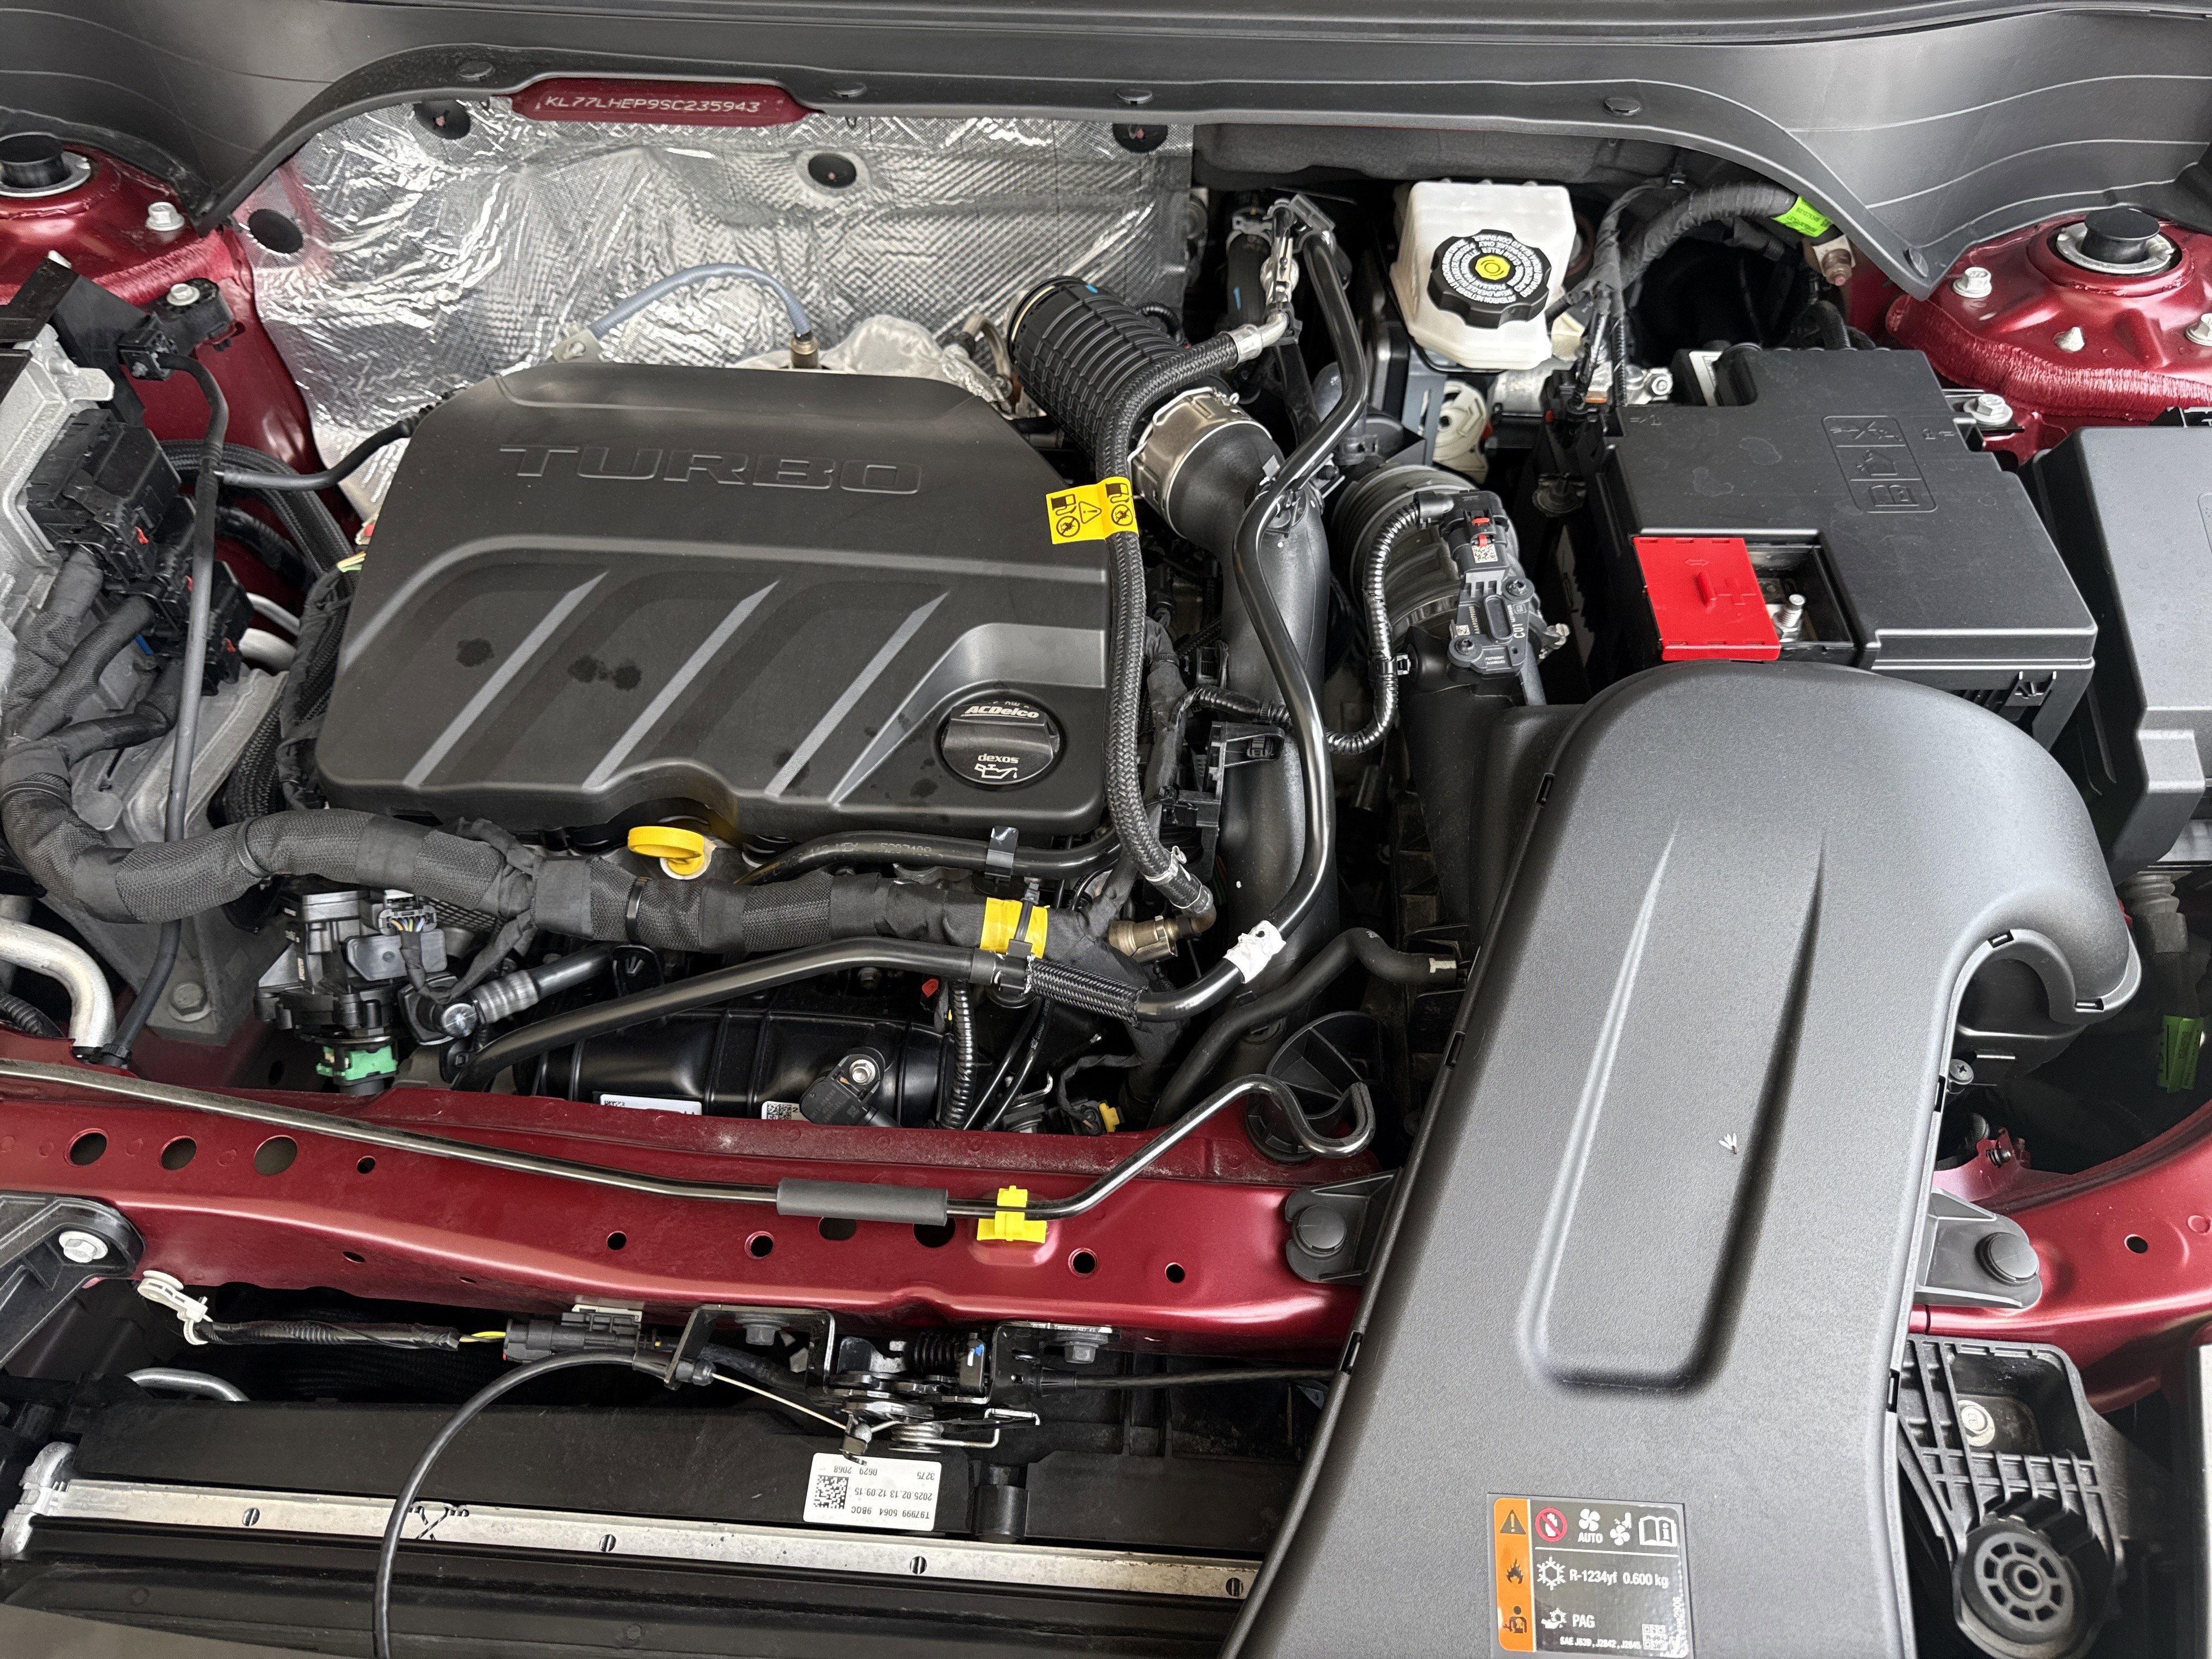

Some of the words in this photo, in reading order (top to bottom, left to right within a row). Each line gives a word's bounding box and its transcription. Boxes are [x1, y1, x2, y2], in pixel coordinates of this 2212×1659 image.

[546, 96, 760, 113] KL77LHEP9SC235943
[500, 444, 923, 494] TURBO
[964, 706, 1039, 718] ACDelco
[978, 753, 1019, 764] dexos
[834, 1465, 852, 1474] 2068
[859, 1466, 878, 1476] 0629
[917, 1471, 935, 1480] 3275
[890, 1489, 932, 1500] 2025.02.13
[879, 1508, 898, 1517] 5064
[902, 1510, 930, 1519] T97999
[1578, 1532, 1603, 1543] AUTO
[1570, 1570, 1617, 1586] R-1234yf
[1622, 1570, 1653, 1585] 0.600
[1655, 1571, 1669, 1589] kg
[1572, 1614, 1595, 1628] PAG
[1560, 1636, 1574, 1645] SAE
